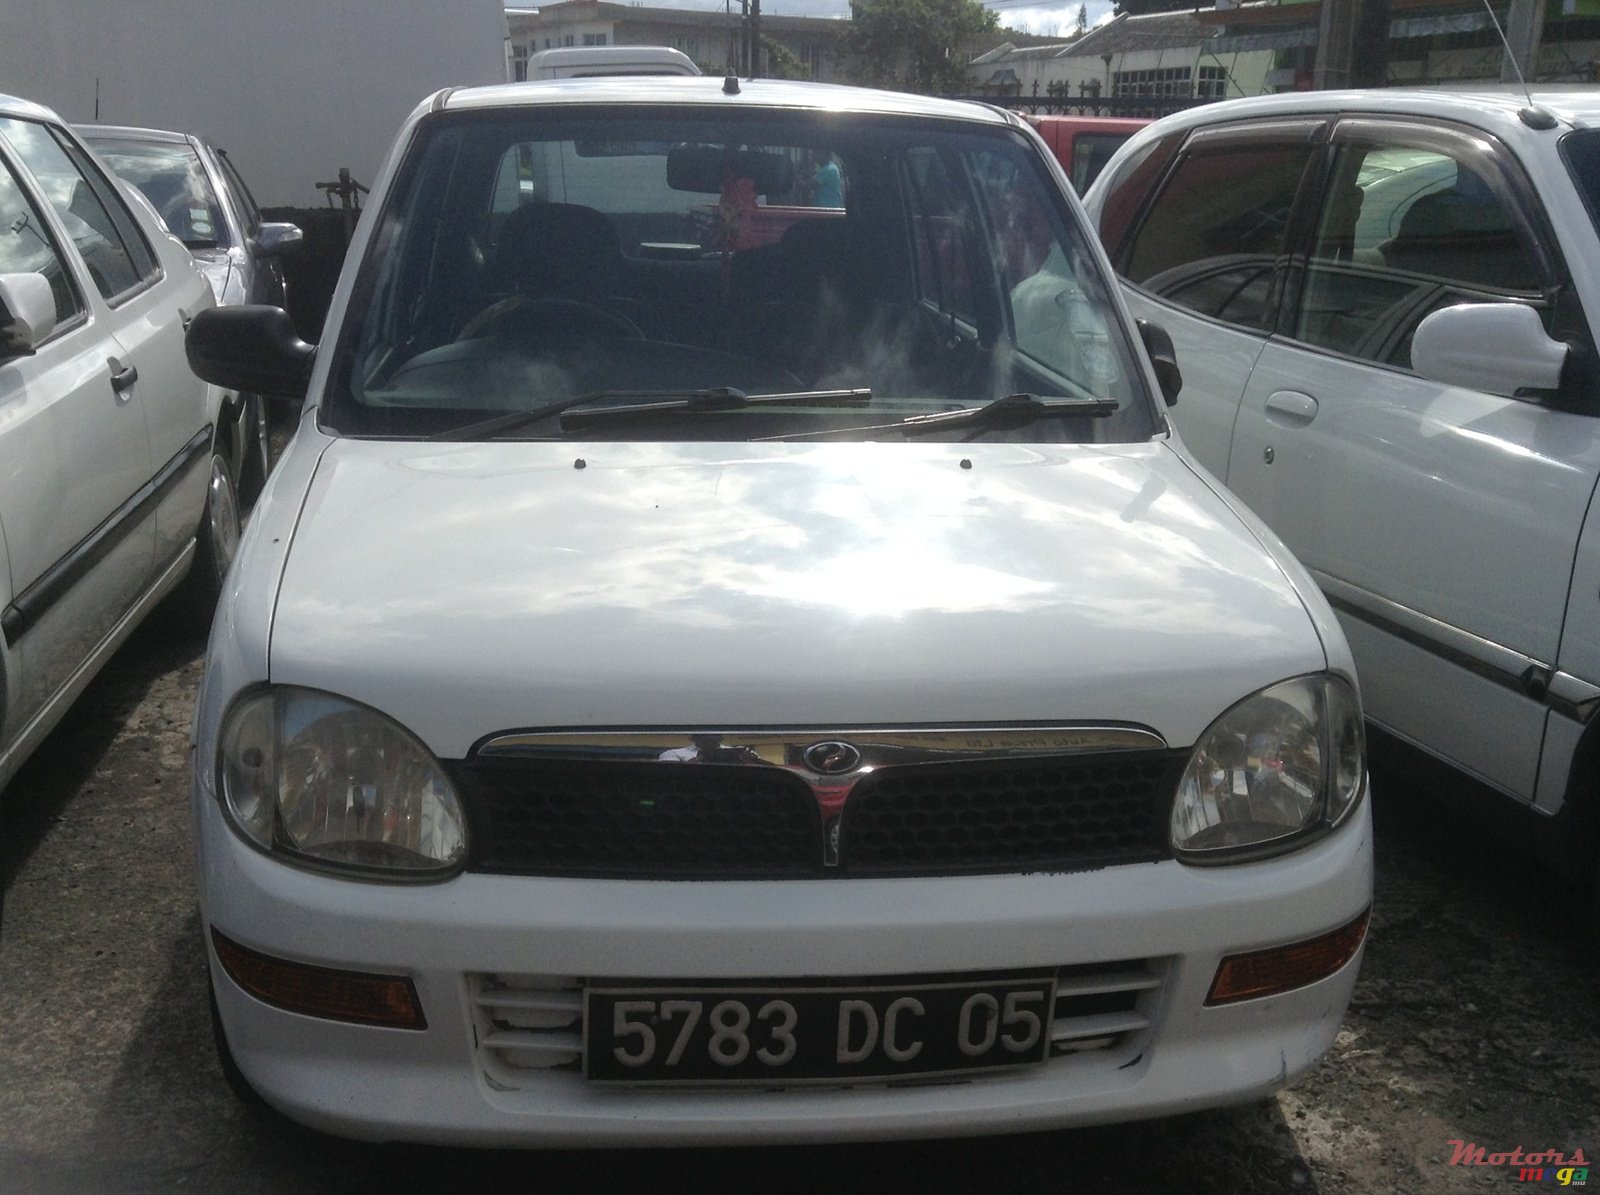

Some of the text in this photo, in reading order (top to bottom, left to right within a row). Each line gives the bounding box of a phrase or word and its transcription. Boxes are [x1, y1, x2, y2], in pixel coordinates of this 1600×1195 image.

[613, 990, 1044, 1067] 5783 DC 05
